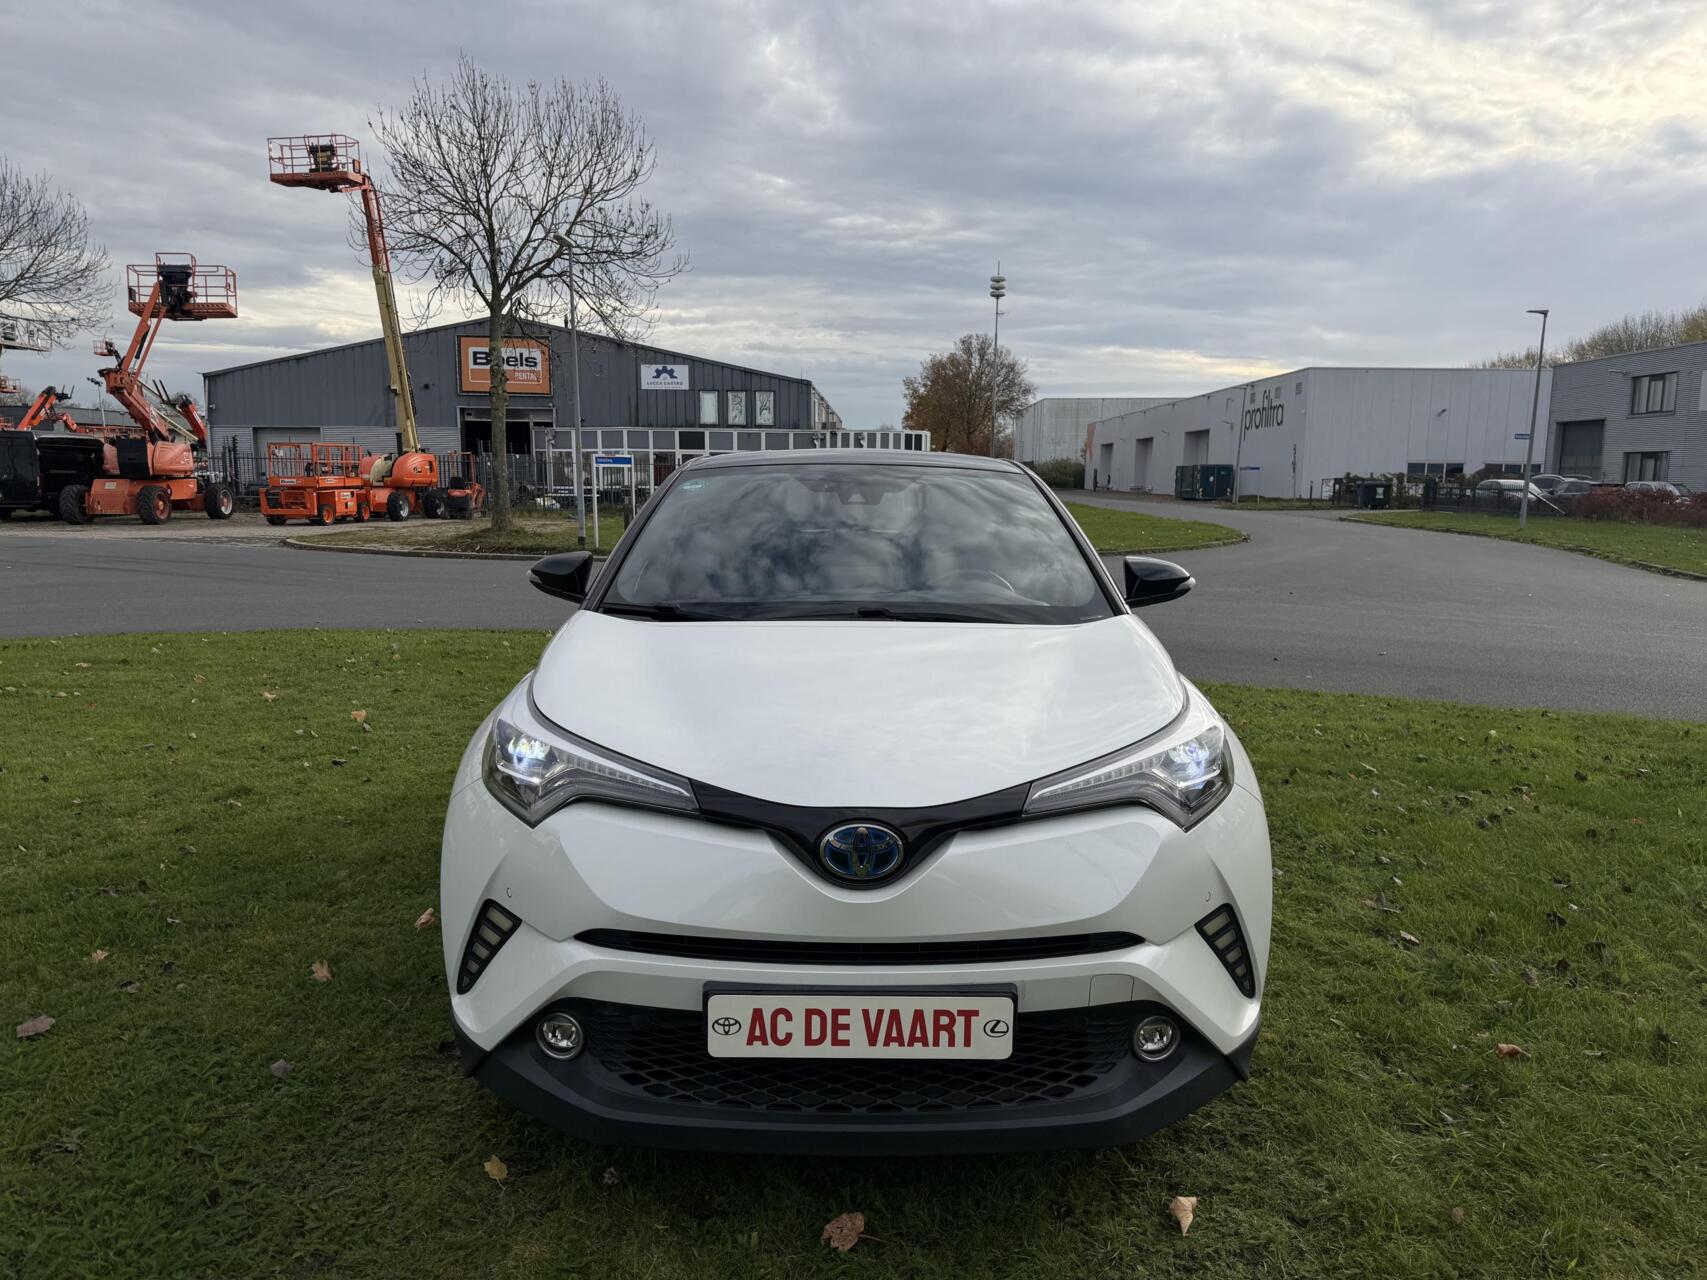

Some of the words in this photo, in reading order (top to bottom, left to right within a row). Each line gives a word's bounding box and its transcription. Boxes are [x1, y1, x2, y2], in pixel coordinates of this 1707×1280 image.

[472, 350, 538, 368] Bels
[514, 372, 537, 381] RENTAL
[1243, 389, 1284, 440] profiltra
[746, 1007, 793, 1047] AC
[804, 1008, 850, 1047] DE
[861, 1009, 980, 1048] VAART
